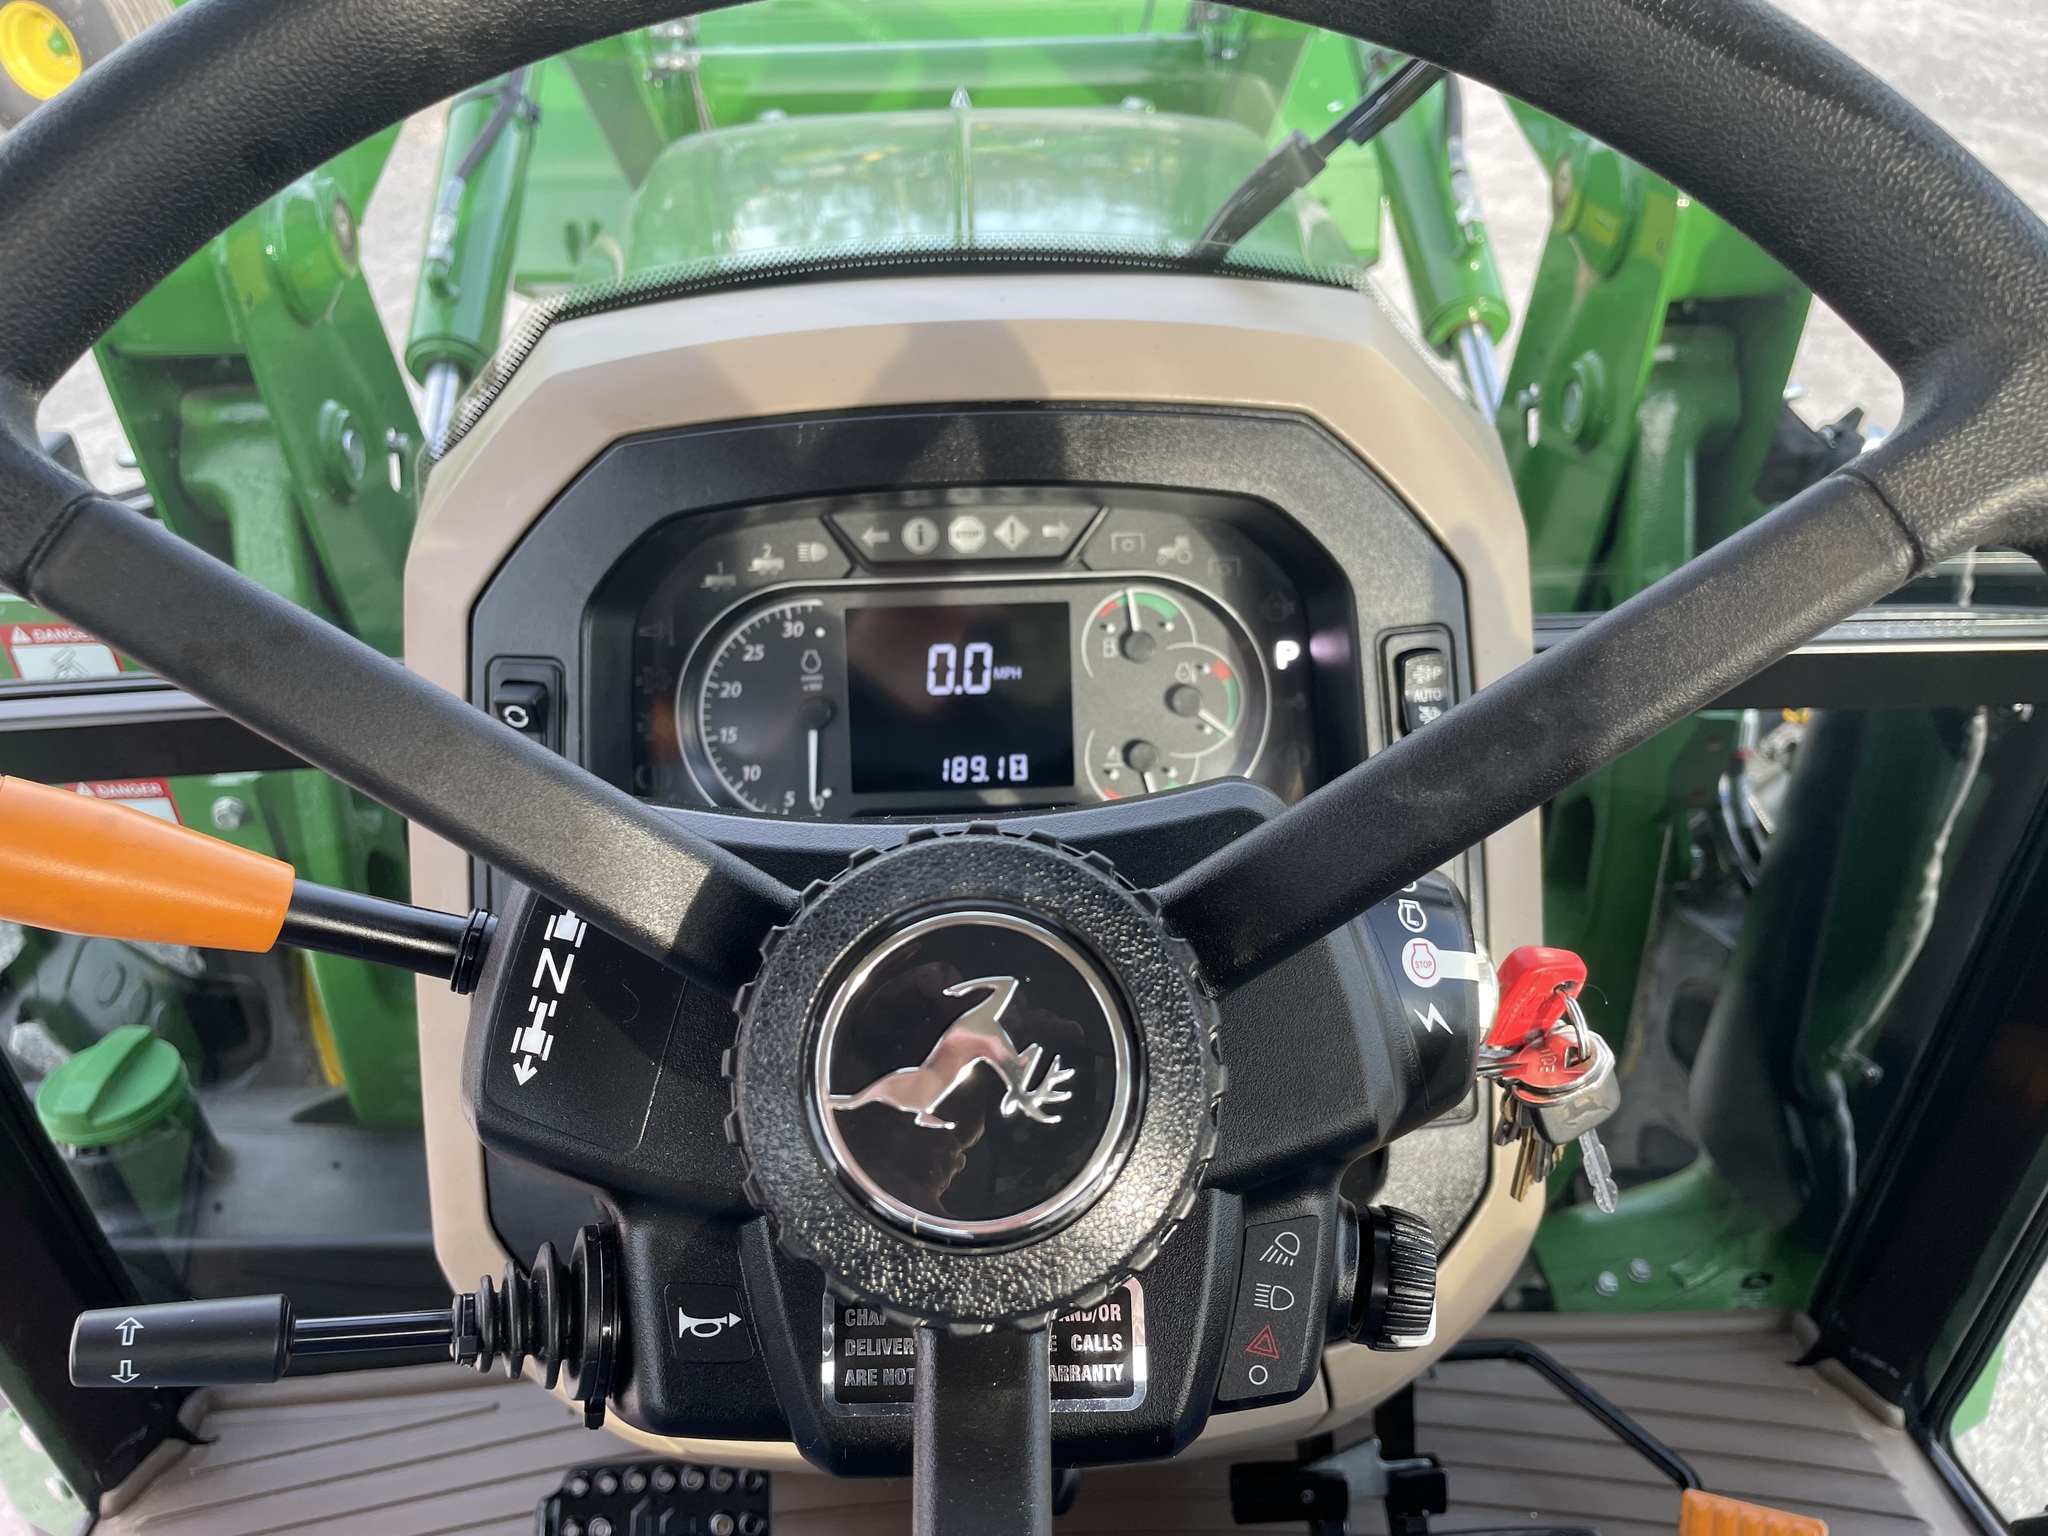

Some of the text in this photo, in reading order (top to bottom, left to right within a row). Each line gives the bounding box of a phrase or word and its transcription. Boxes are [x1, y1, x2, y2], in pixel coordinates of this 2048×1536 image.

[782, 620, 805, 639] 30
[742, 643, 765, 662] 25
[1276, 640, 1300, 670] P
[926, 642, 1022, 696] 0.0 MPH
[720, 680, 742, 699] 20
[1414, 689, 1442, 703] AUTO
[720, 726, 738, 744] 15
[741, 764, 761, 782] 10
[942, 754, 1005, 784] 189.1
[96, 782, 163, 799] DANGER
[784, 790, 796, 808] 5
[531, 947, 575, 994] N
[1414, 960, 1433, 969] STOP
[845, 1308, 887, 1327] CHA
[1070, 1333, 1123, 1352] CALLS
[844, 1368, 878, 1387] ARE
[882, 1367, 916, 1386] NOT
